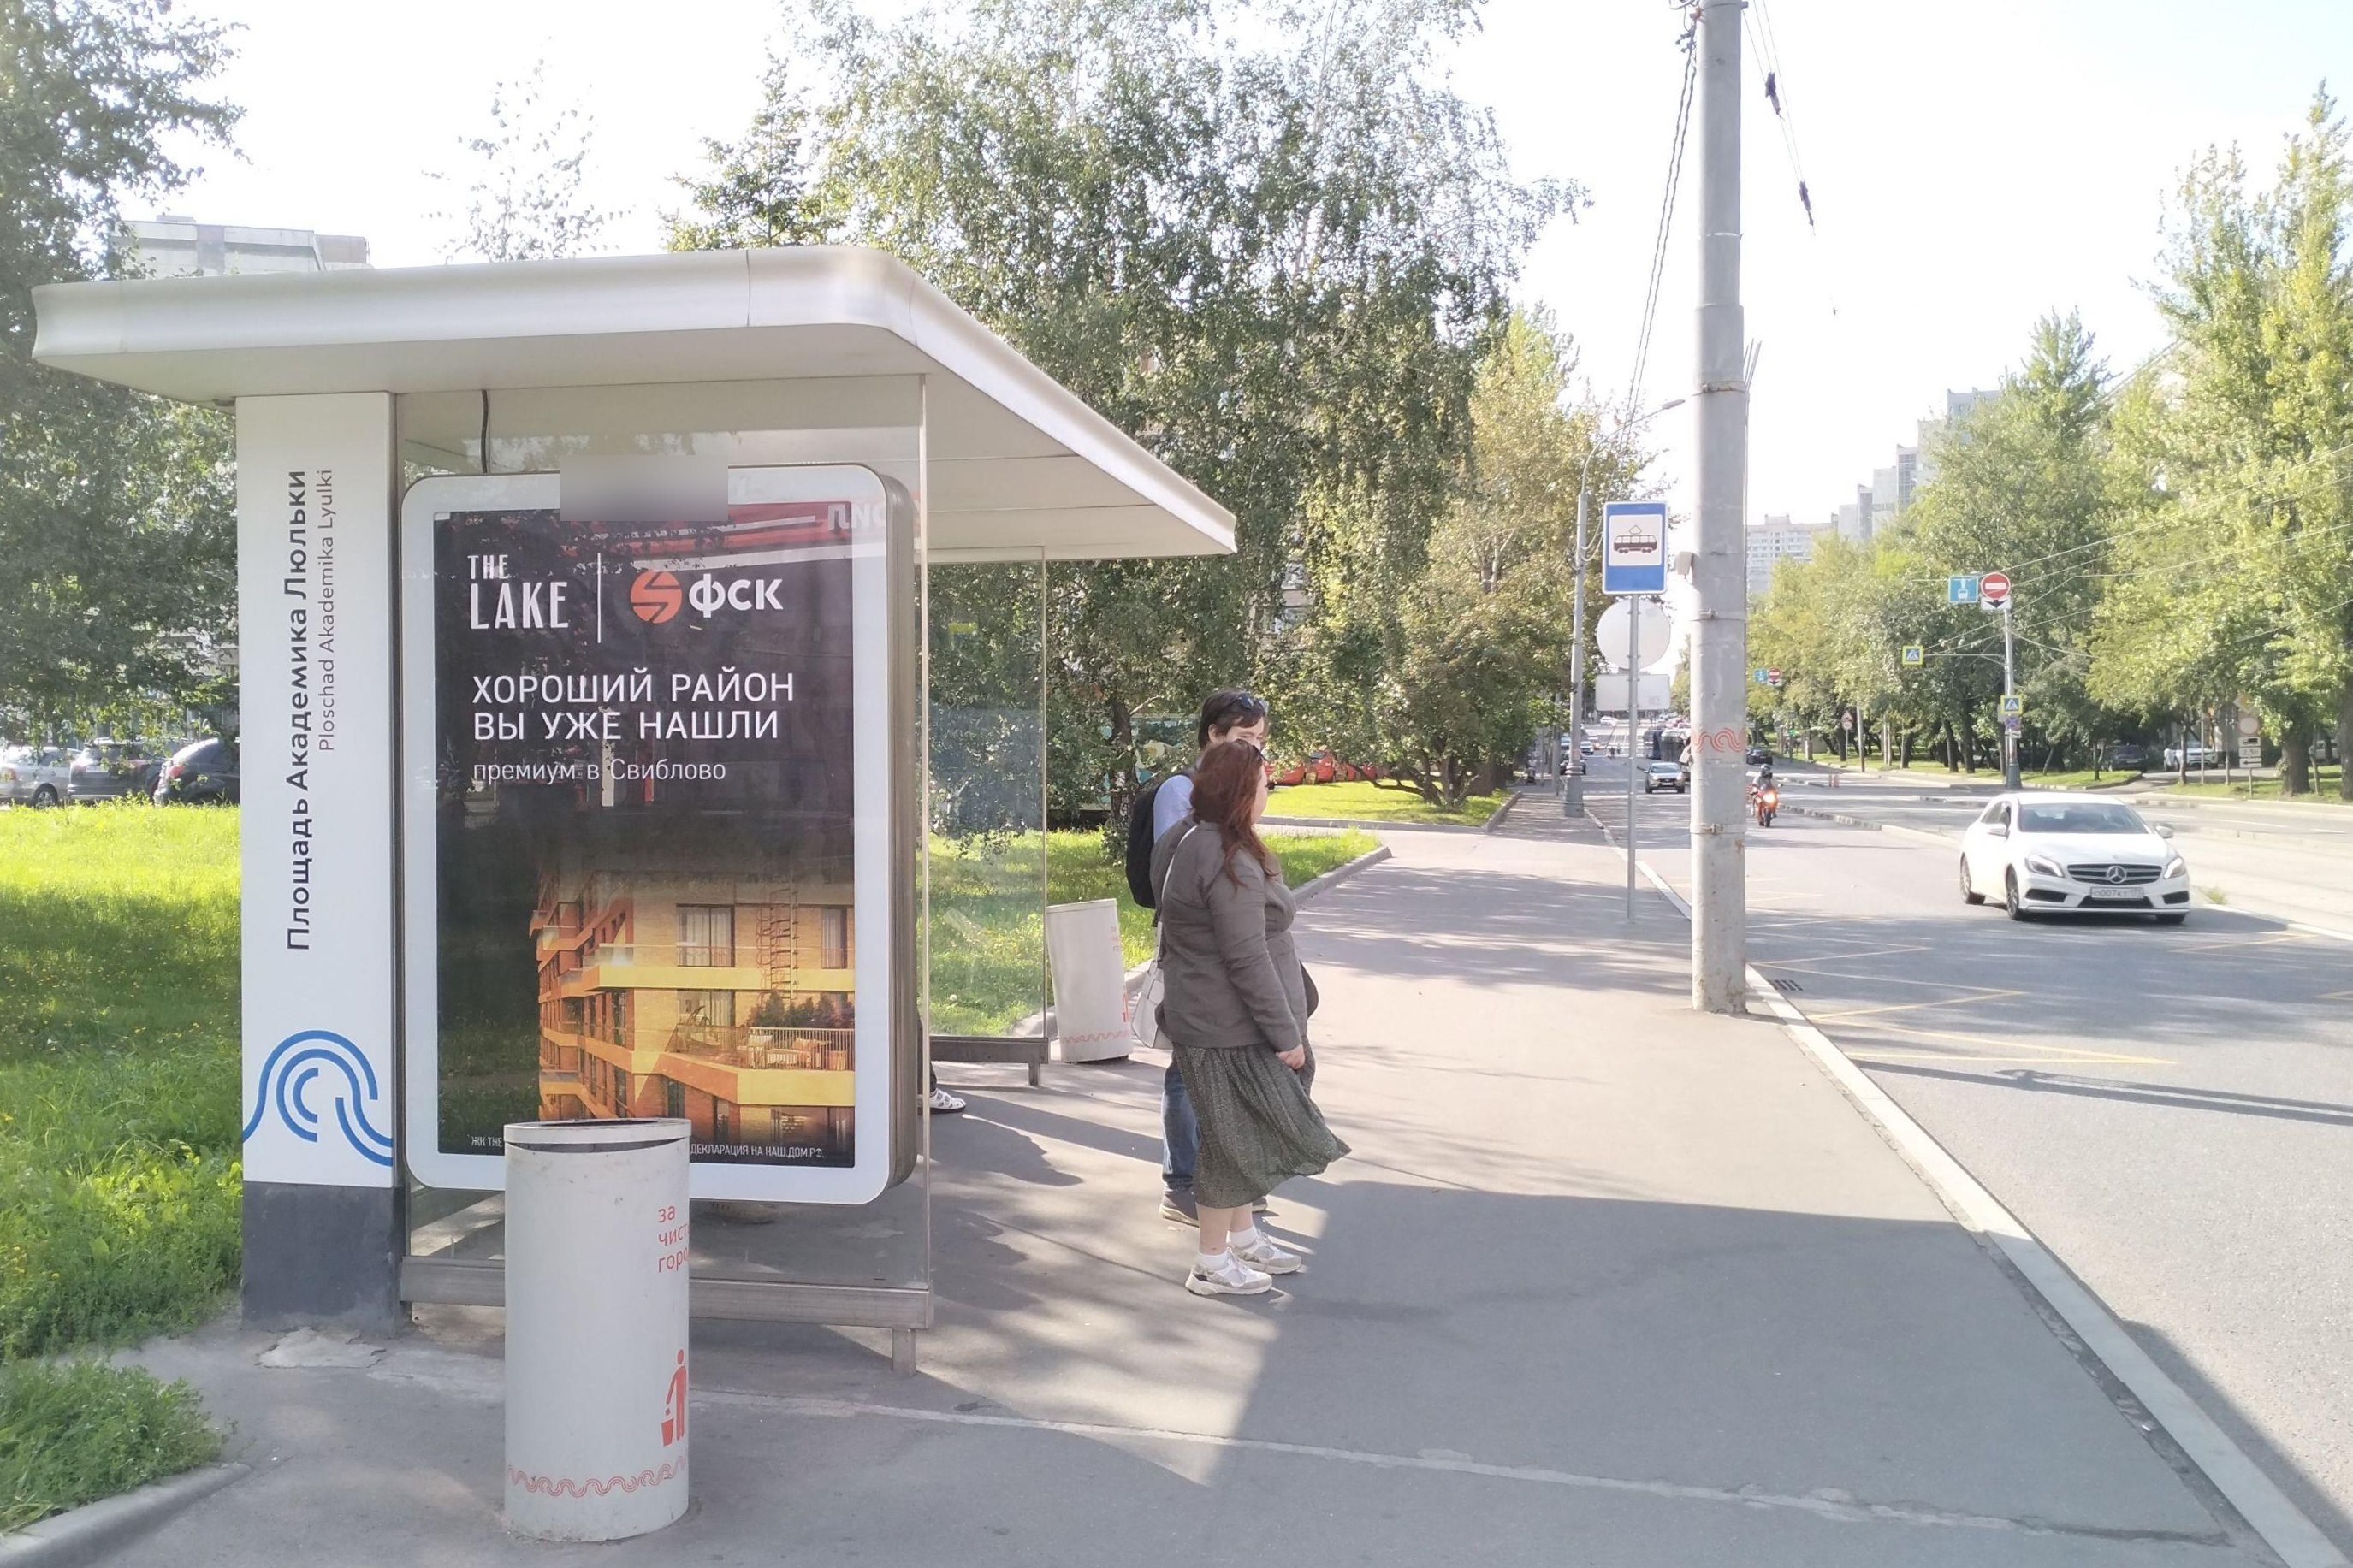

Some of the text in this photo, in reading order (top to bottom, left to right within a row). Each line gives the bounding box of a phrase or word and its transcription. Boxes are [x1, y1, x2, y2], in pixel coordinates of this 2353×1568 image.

[467, 554, 509, 580] THE
[316, 469, 337, 751] Ploschad Akademika Lyulki
[470, 582, 569, 630] LAKE
[472, 666, 794, 704] ХОРОШИЙ РАЙОН
[283, 470, 313, 950] Площадь Академика Люльки
[473, 710, 779, 741] ВЫ УЖЕ НАШЛИ
[472, 758, 726, 786] премиум в Свиблово
[471, 1136, 503, 1148] ЖК THE
[690, 1143, 750, 1157] ДЕКЛАРАЦИЯ
[751, 1145, 763, 1156] НА
[658, 1205, 676, 1223] за
